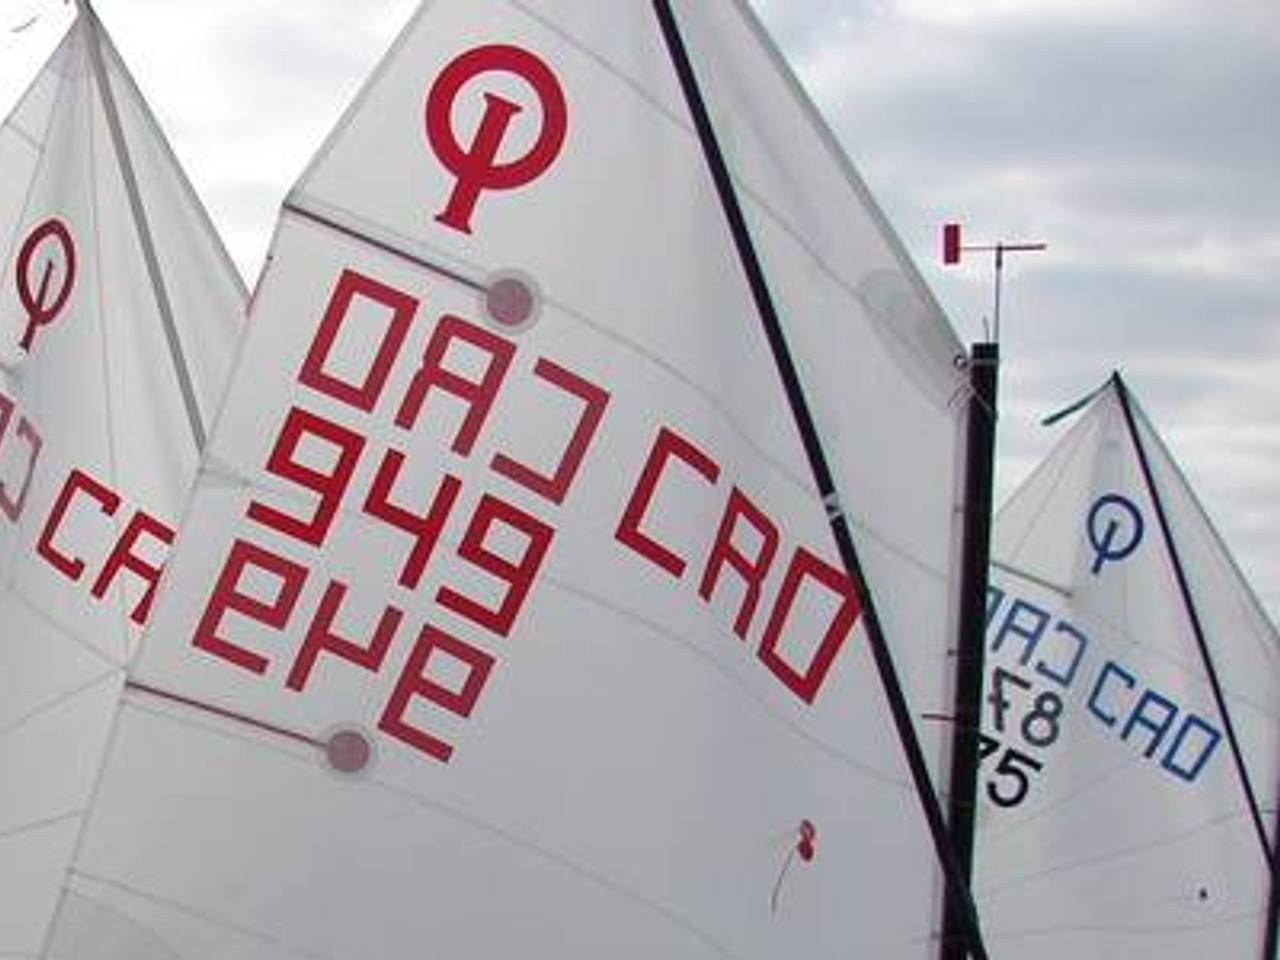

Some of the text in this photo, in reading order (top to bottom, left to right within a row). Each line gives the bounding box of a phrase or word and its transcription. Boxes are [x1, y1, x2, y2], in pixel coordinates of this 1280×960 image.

[35, 469, 176, 625] CR
[246, 406, 555, 637] 949
[614, 426, 863, 705] CRO
